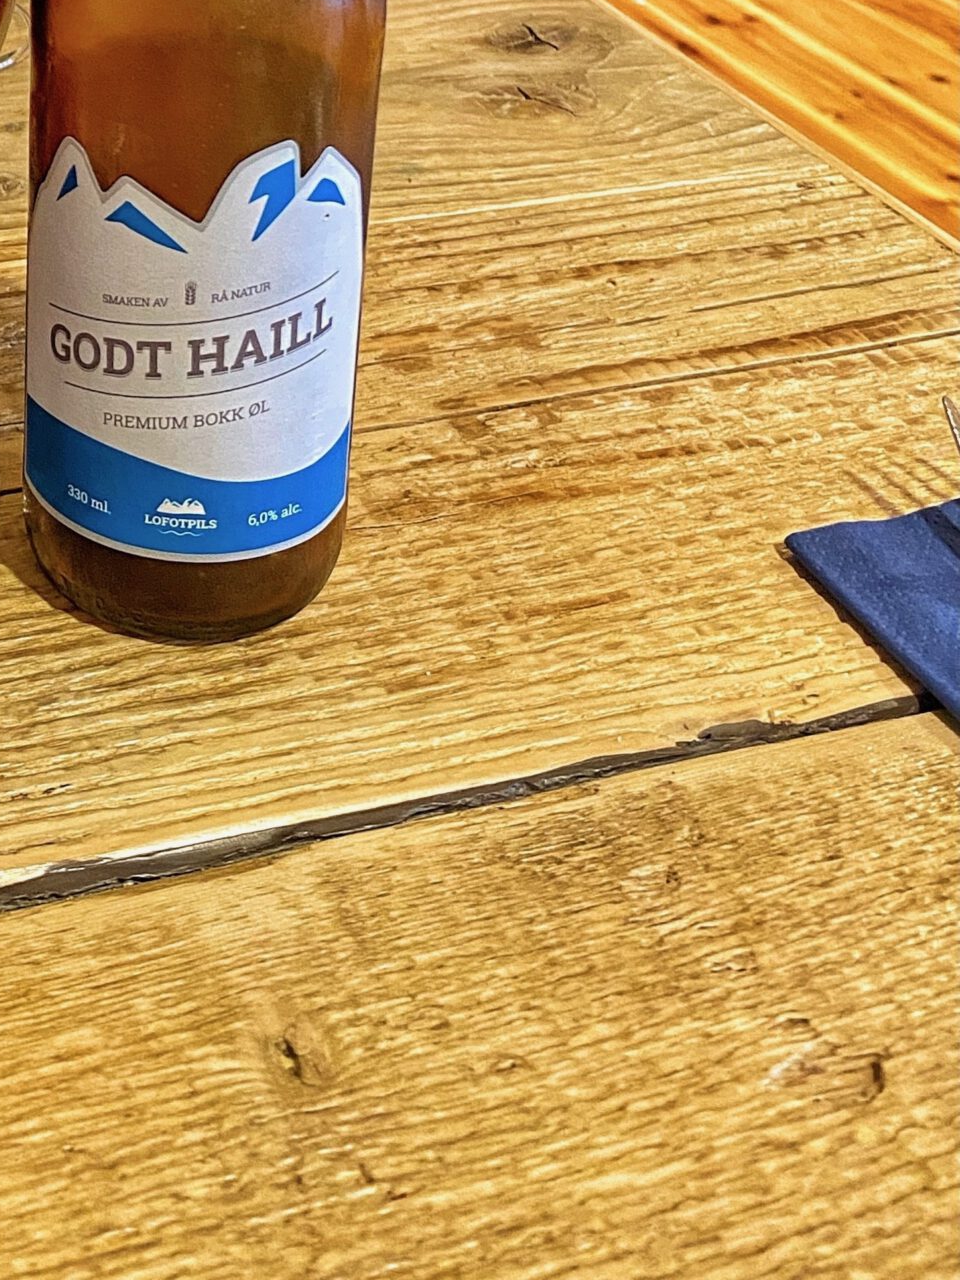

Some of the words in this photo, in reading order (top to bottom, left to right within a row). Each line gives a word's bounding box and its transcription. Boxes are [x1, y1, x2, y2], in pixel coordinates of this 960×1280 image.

[102, 294, 150, 308] SMAKEN
[153, 297, 169, 308] AV
[211, 289, 229, 304] RÅ
[230, 282, 272, 300] NATUR
[50, 323, 172, 380] GODT
[187, 297, 333, 380] HAILL
[103, 412, 189, 430] PREMIUM
[193, 406, 245, 428] BOKK
[248, 400, 271, 418] ØL
[67, 484, 89, 504] 330
[144, 514, 218, 530] LOFOTPILS
[248, 509, 279, 527] 6,0%
